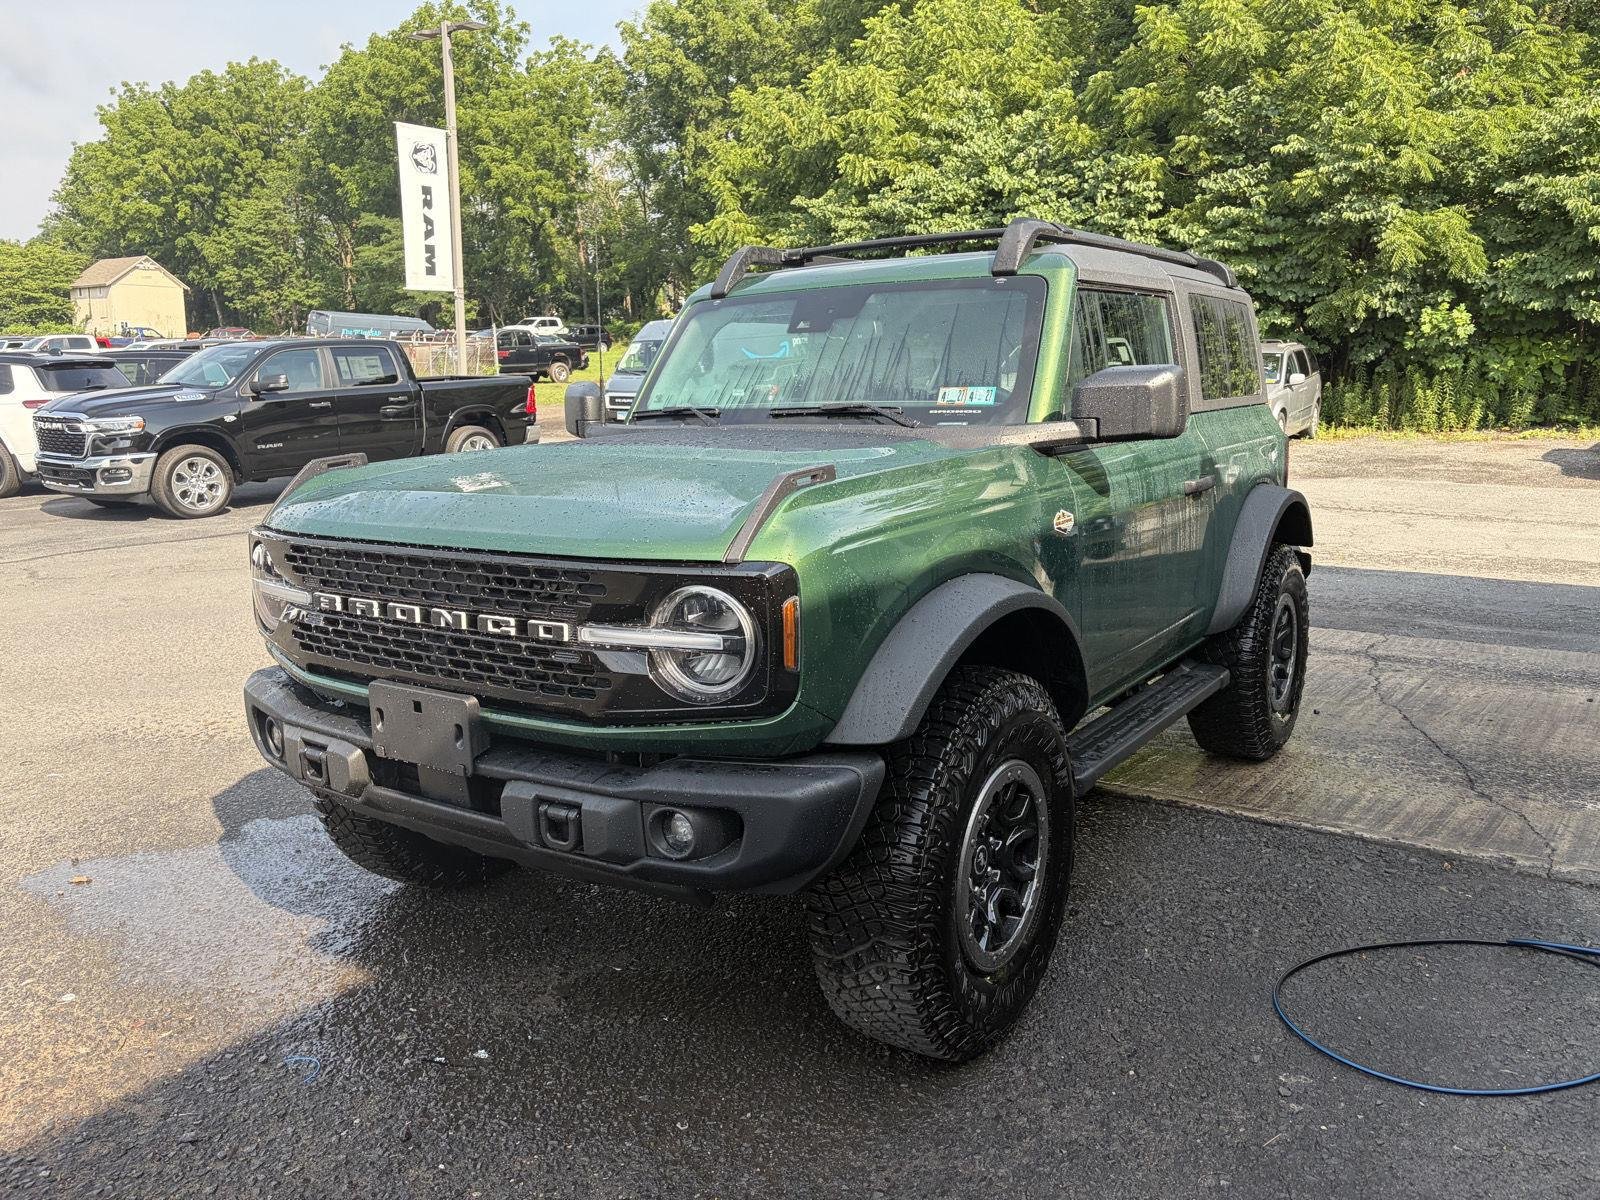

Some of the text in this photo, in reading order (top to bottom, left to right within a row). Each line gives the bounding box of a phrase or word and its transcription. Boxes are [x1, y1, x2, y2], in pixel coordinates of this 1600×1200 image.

[421, 185, 436, 276] RAM
[37, 421, 63, 431] RAM
[312, 591, 570, 642] BRONCO
